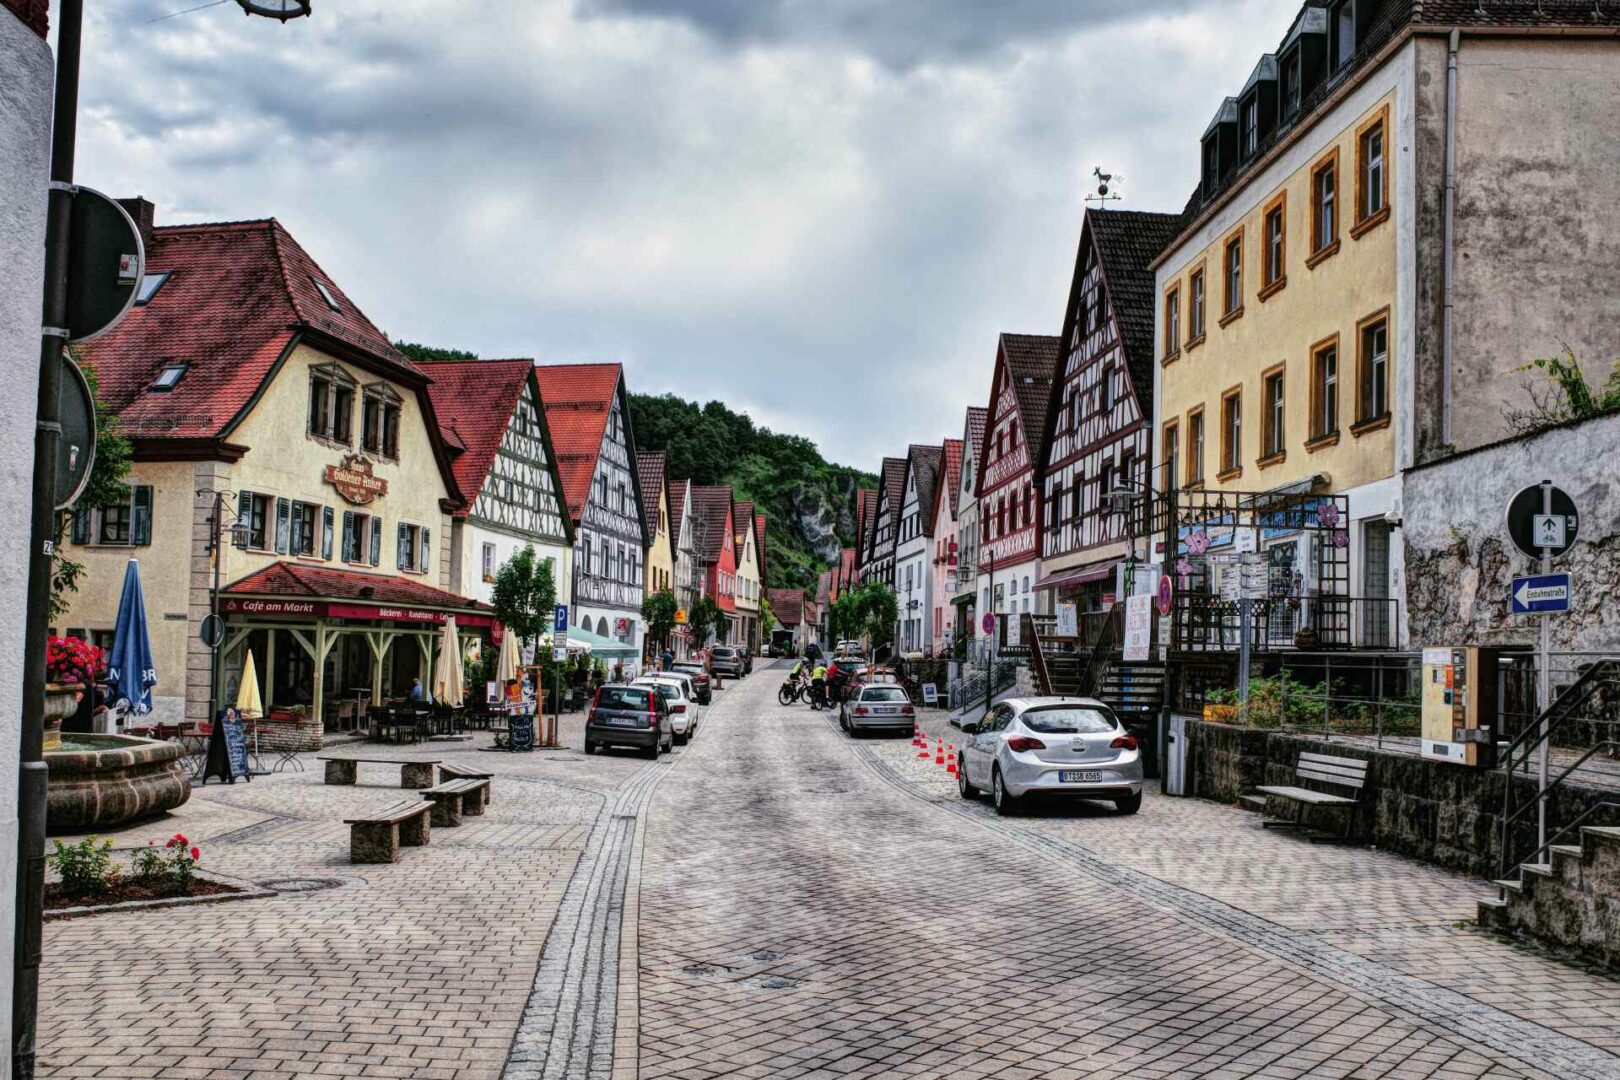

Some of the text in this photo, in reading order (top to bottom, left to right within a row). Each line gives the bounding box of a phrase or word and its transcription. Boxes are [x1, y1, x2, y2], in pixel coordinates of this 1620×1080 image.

[333, 468, 382, 490] Goldener Anker
[1526, 588, 1566, 599] Einbahnstraße
[242, 601, 314, 613] Café am Markt
[379, 608, 402, 618] Bäckerei
[557, 608, 566, 629] P
